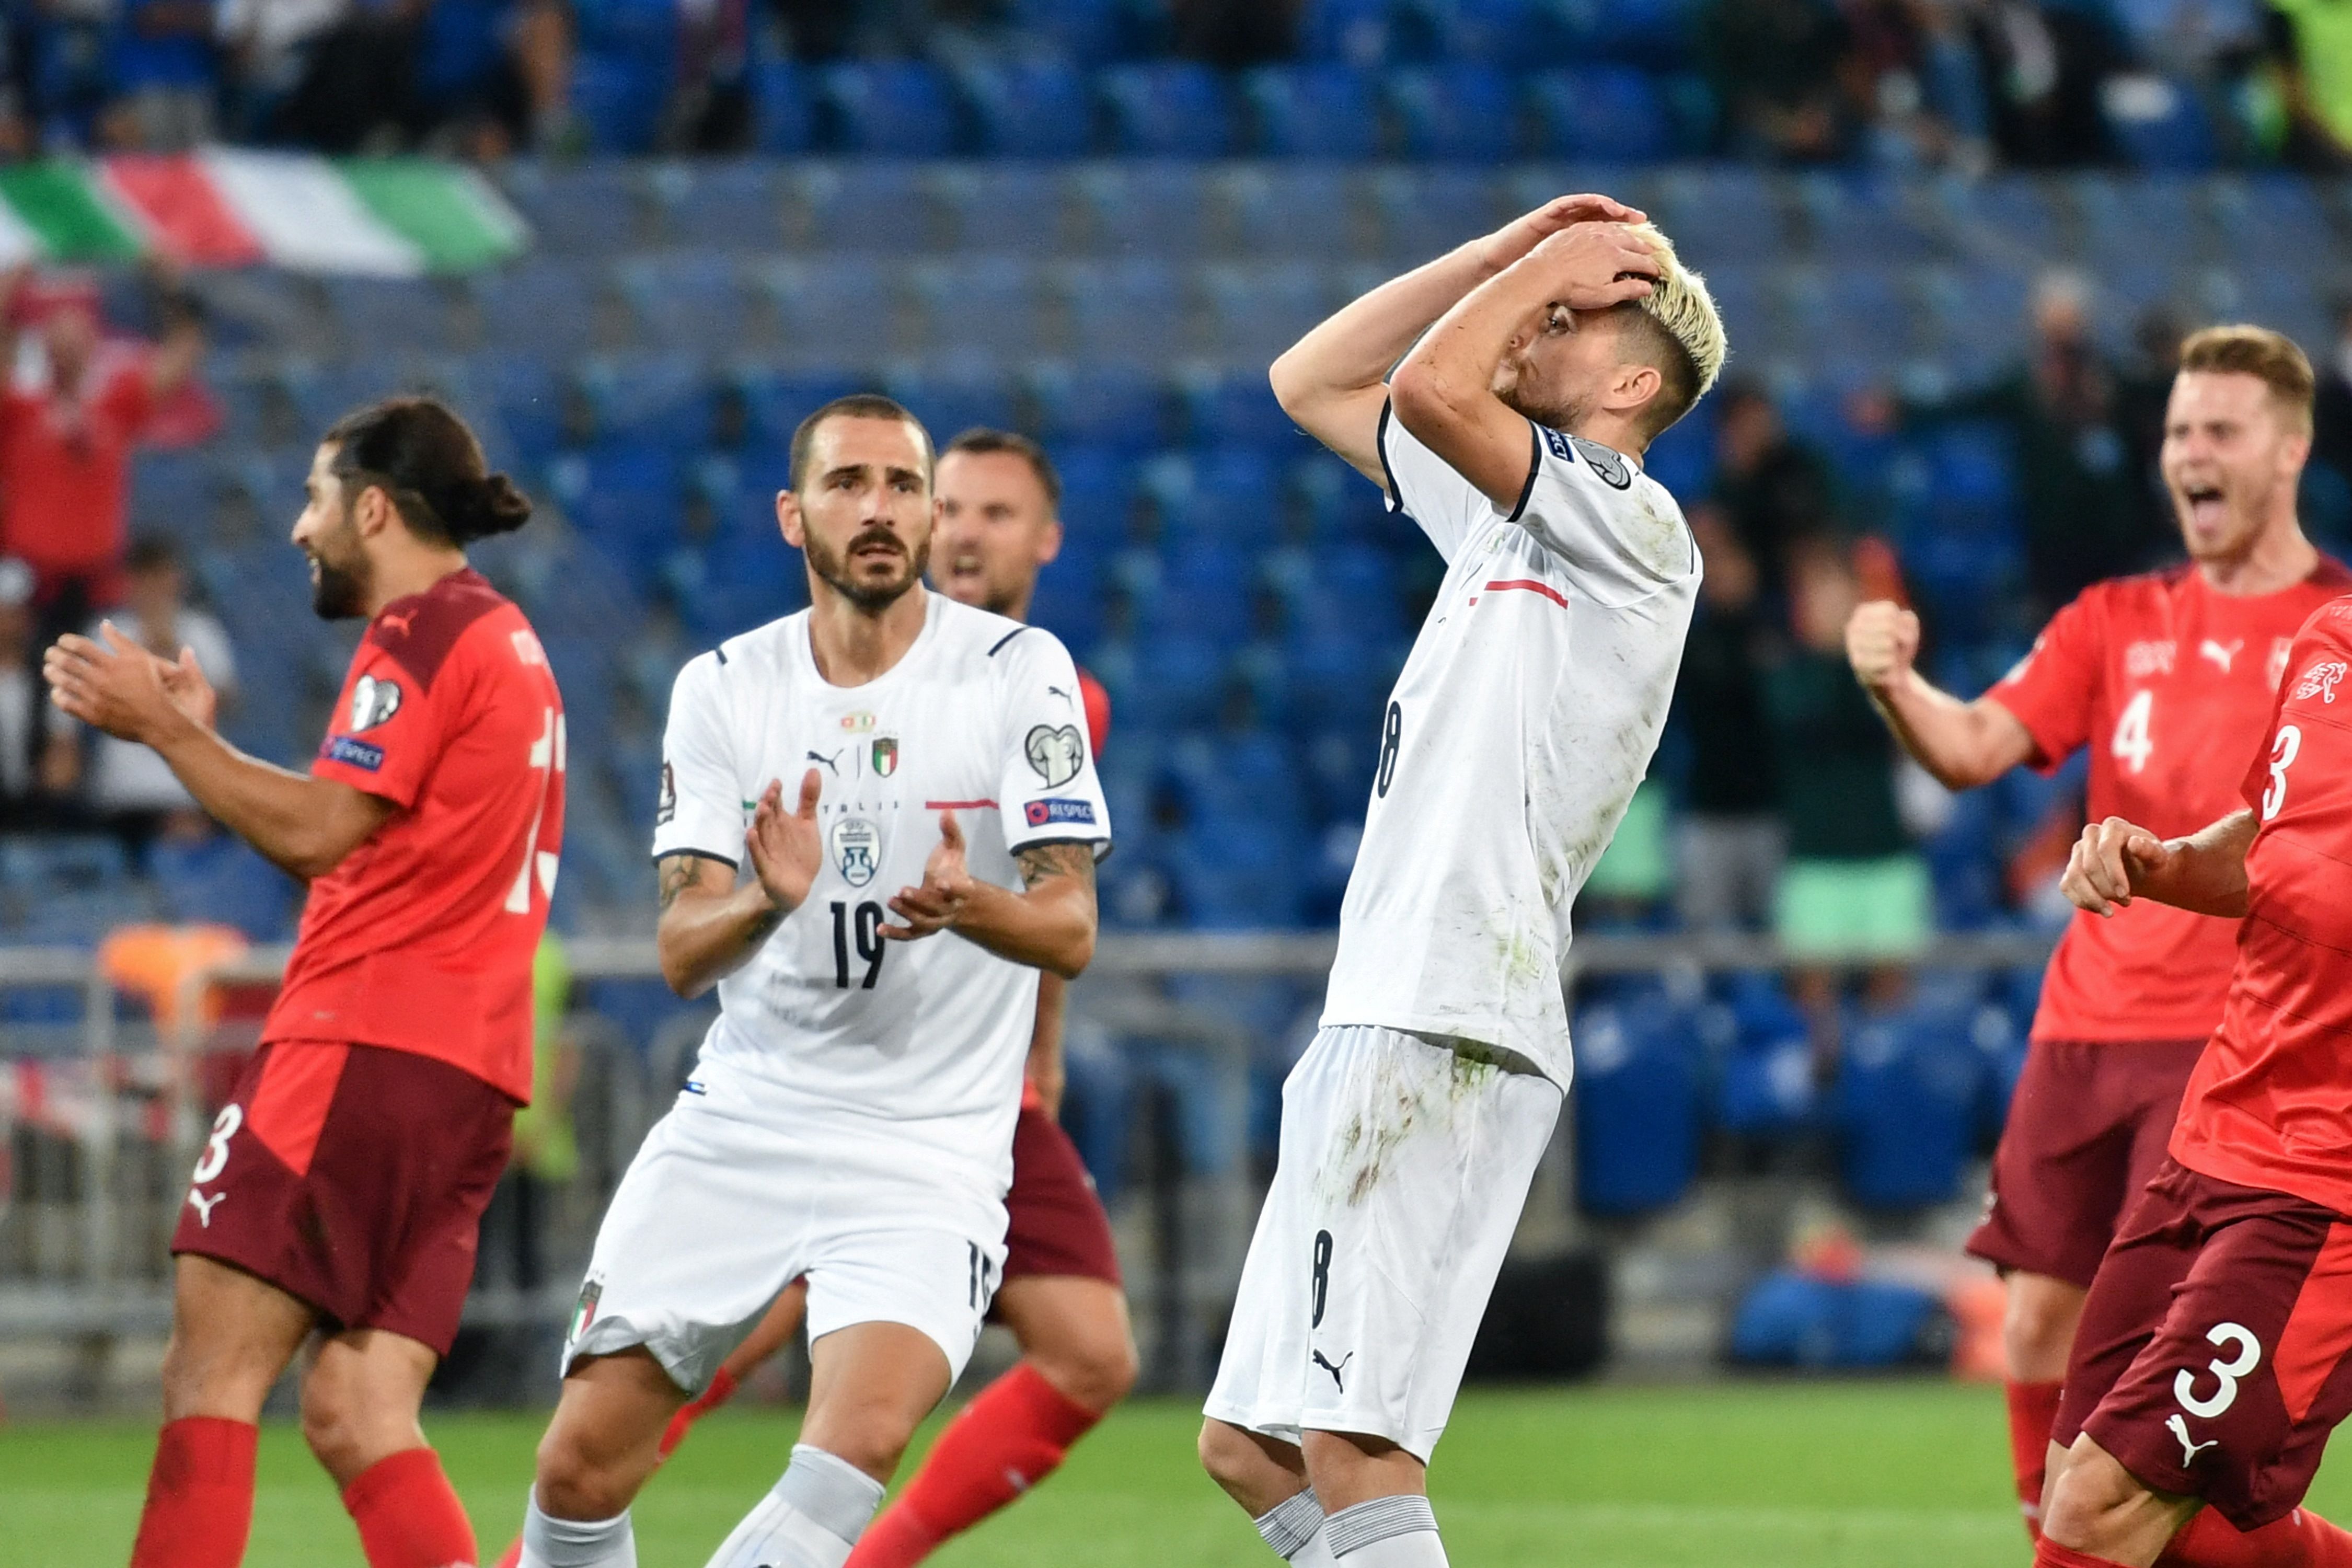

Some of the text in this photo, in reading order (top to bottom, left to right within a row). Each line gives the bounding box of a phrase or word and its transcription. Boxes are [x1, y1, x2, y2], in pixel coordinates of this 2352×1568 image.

[1546, 426, 1568, 460] PECT
[1377, 700, 1402, 799] 8
[2110, 689, 2153, 774] 4
[2263, 724, 2302, 821] 3
[830, 901, 885, 989] 19
[193, 1103, 243, 1184] 3
[1312, 1229, 1333, 1330] 8
[2173, 1322, 2261, 1418] 3
